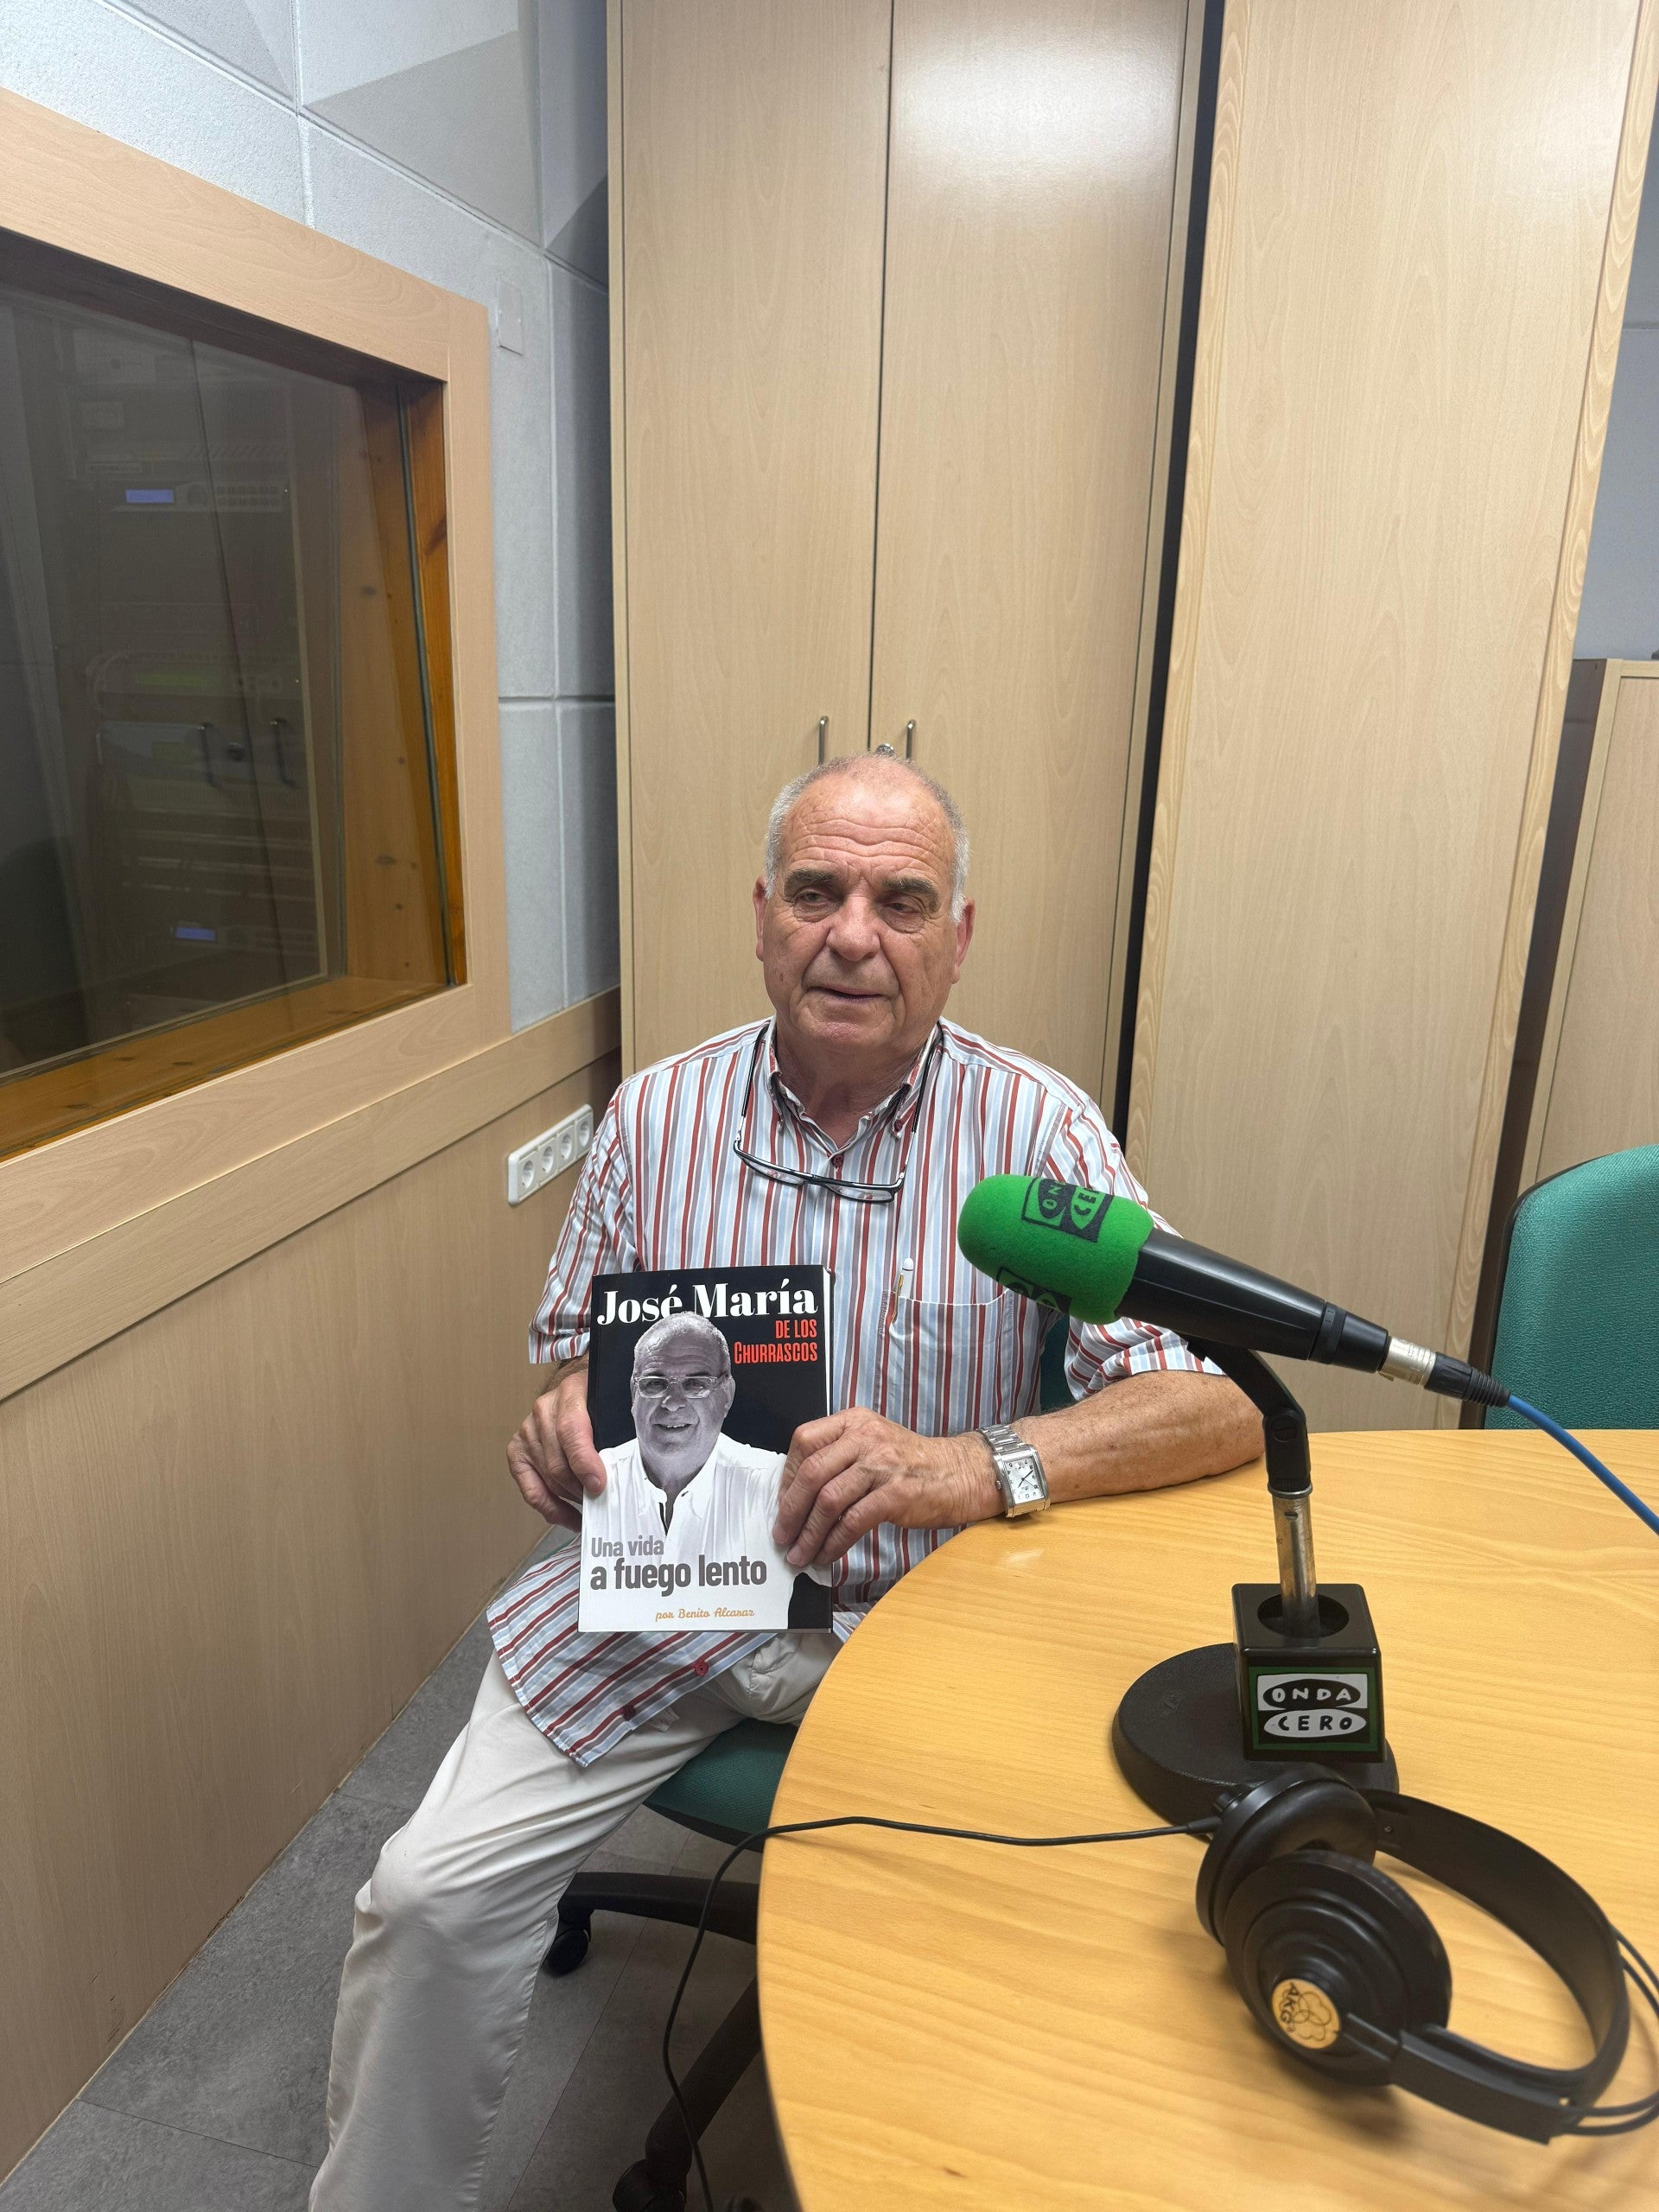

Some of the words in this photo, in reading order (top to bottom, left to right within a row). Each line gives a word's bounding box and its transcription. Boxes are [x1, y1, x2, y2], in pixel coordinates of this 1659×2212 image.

[596, 1284, 683, 1325] José
[692, 1278, 818, 1318] María
[775, 1320, 790, 1339] DE
[795, 1319, 817, 1338] LOS
[591, 1537, 624, 1557] Una
[627, 1535, 664, 1556] vida
[590, 1566, 607, 1590] a
[614, 1557, 691, 1597] fuego
[698, 1554, 767, 1587] lento
[655, 1611, 674, 1622] por
[678, 1607, 710, 1619] Benito
[714, 1607, 755, 1618] Alcaraz
[1271, 1688, 1352, 1702] ONDA
[1278, 1715, 1353, 1731] CERO
